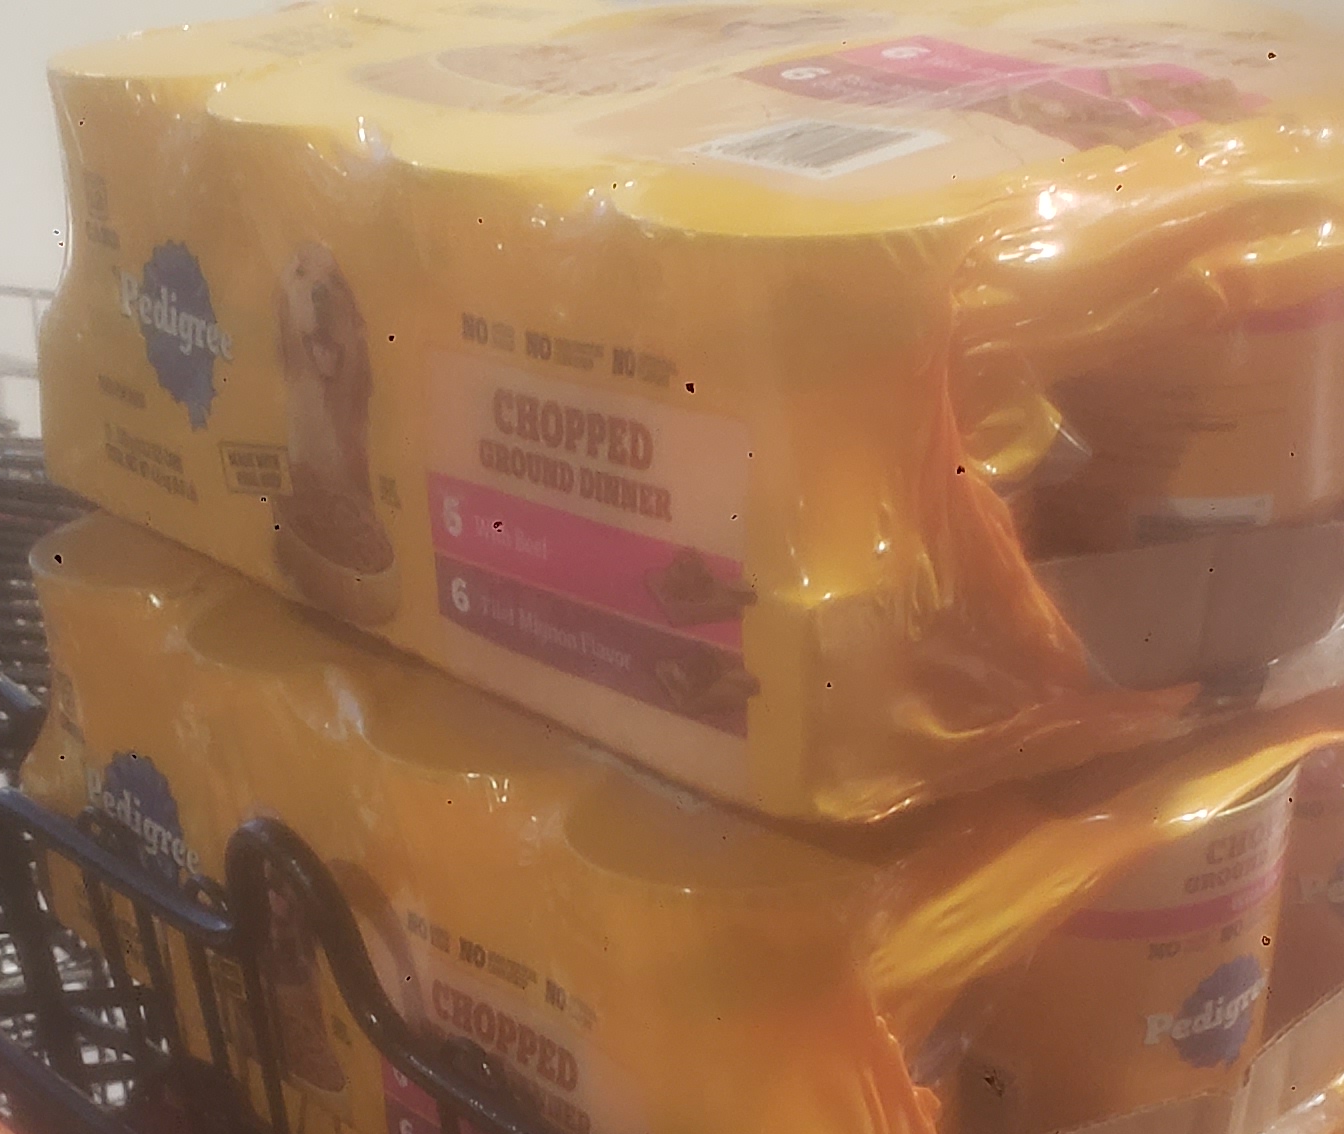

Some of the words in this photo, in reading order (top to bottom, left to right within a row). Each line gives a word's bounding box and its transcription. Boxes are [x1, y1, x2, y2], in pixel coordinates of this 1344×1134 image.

[120, 270, 234, 360] Pedigree
[462, 312, 488, 344] NO
[525, 331, 552, 360] NO
[493, 388, 653, 471] CHOPPED
[478, 438, 575, 494] GROUND
[579, 467, 672, 522] DINNER
[451, 577, 470, 613] 6
[432, 978, 579, 1084] CHOPPED
